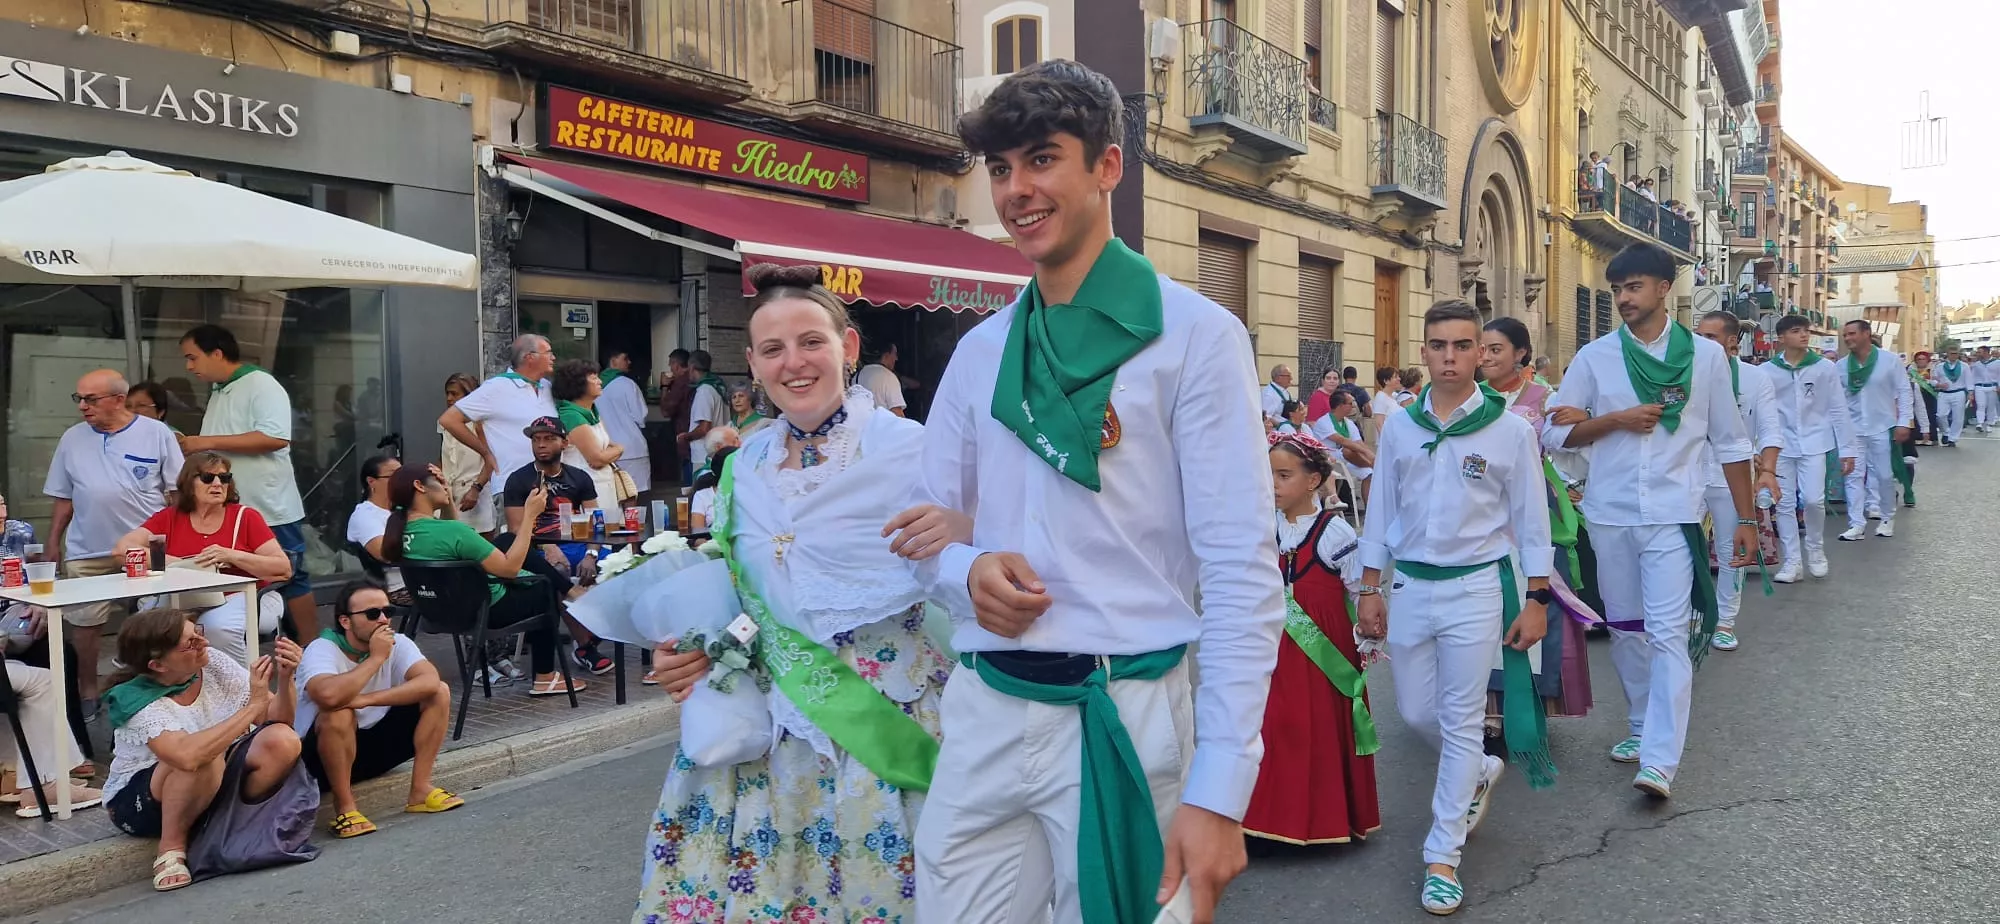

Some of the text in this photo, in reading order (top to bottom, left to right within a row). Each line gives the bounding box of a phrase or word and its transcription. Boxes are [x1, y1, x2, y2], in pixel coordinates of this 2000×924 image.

[69, 67, 299, 138] KLASIKS
[578, 96, 695, 140] CAFETERIA
[557, 120, 722, 172] RESTAURANTE
[732, 139, 837, 190] Hiedra
[321, 258, 463, 277] CERVECEROS INDEPENDIENTES
[821, 264, 1006, 309] BAR Hiedra
